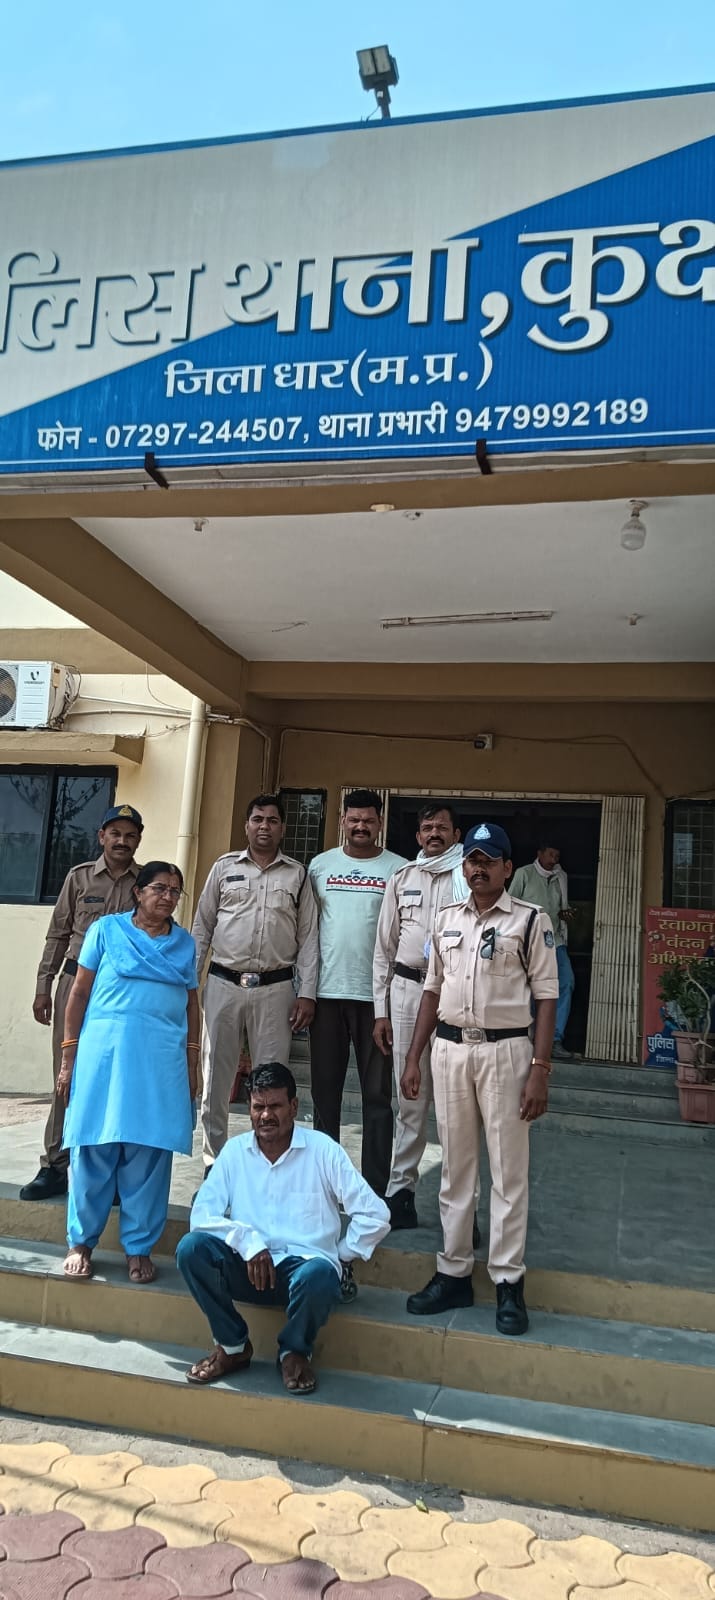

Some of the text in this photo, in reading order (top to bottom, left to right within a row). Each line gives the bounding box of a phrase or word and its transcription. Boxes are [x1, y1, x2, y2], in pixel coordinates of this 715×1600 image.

[164, 359, 267, 398] जिला
[37, 420, 82, 451] फोन
[105, 415, 310, 449] 07297-244507,
[318, 411, 374, 440] थाना
[376, 401, 448, 439] प्रभारी
[455, 397, 649, 433] 9479992189
[328, 874, 385, 886] LACOSTE
[657, 919, 715, 933] स्वागत
[665, 934, 705, 950] वंदन
[647, 1033, 675, 1053] पुलिस
